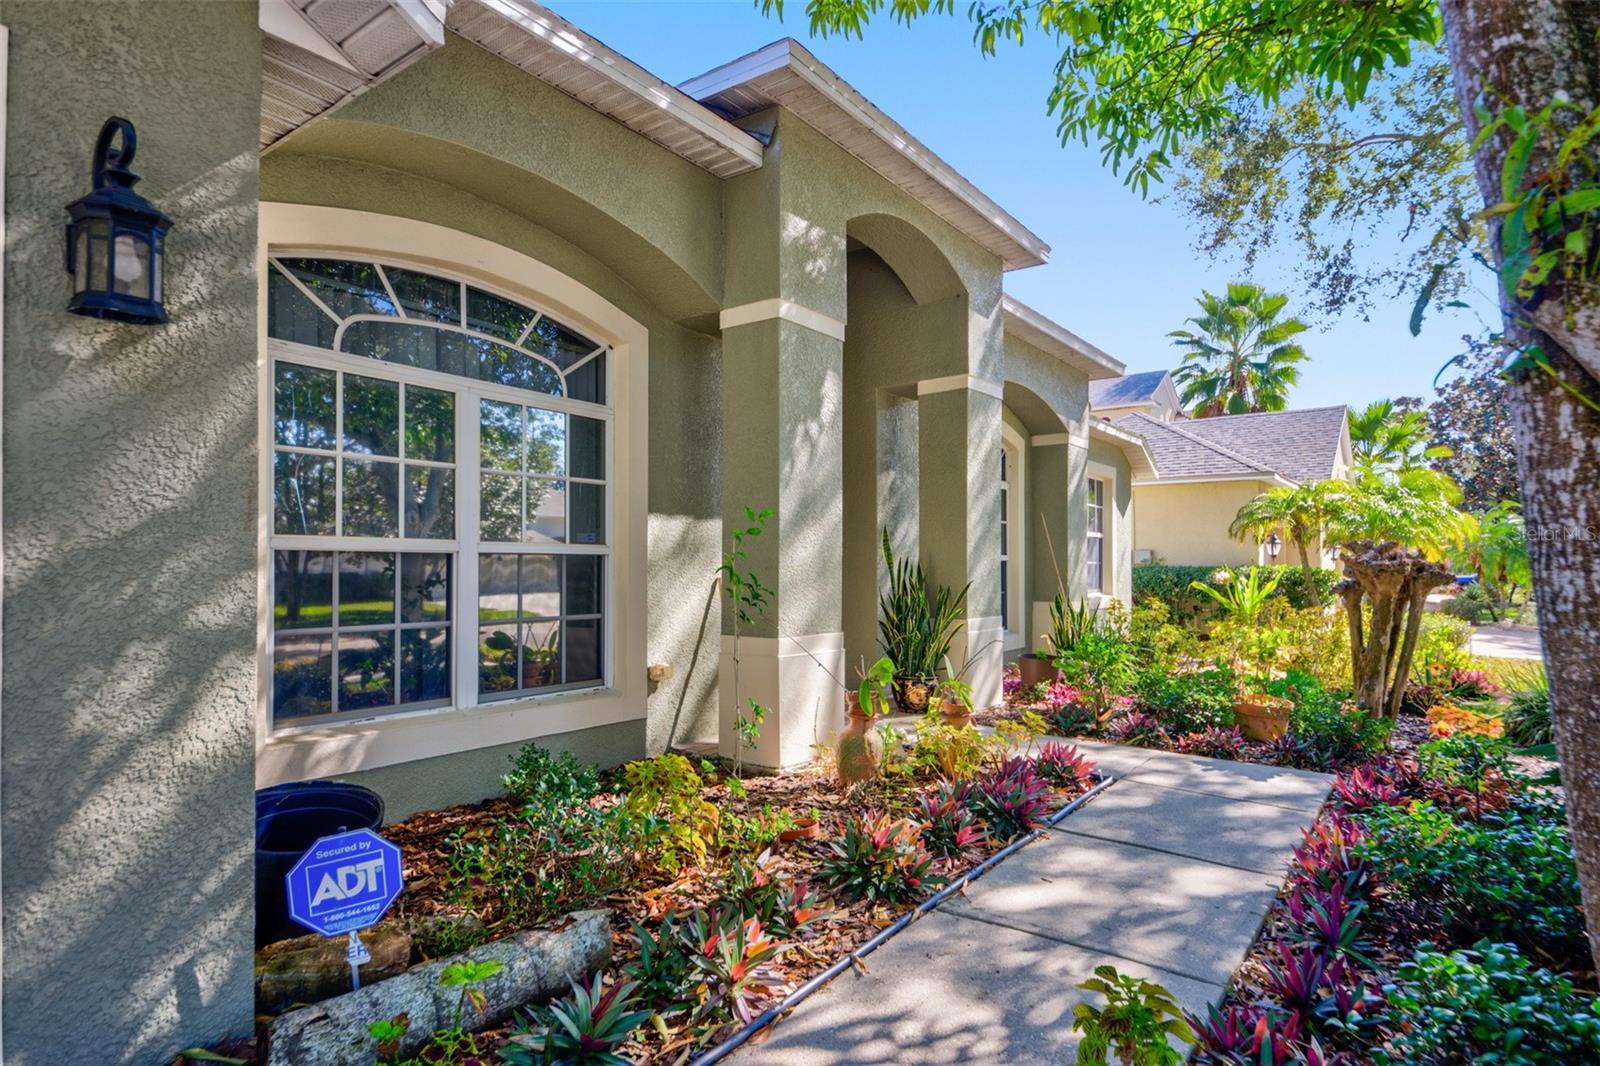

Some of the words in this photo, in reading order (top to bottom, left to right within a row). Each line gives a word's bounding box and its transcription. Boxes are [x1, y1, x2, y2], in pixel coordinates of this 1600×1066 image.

[315, 843, 357, 859] Secured
[358, 840, 371, 854] by
[310, 858, 384, 907] ADT
